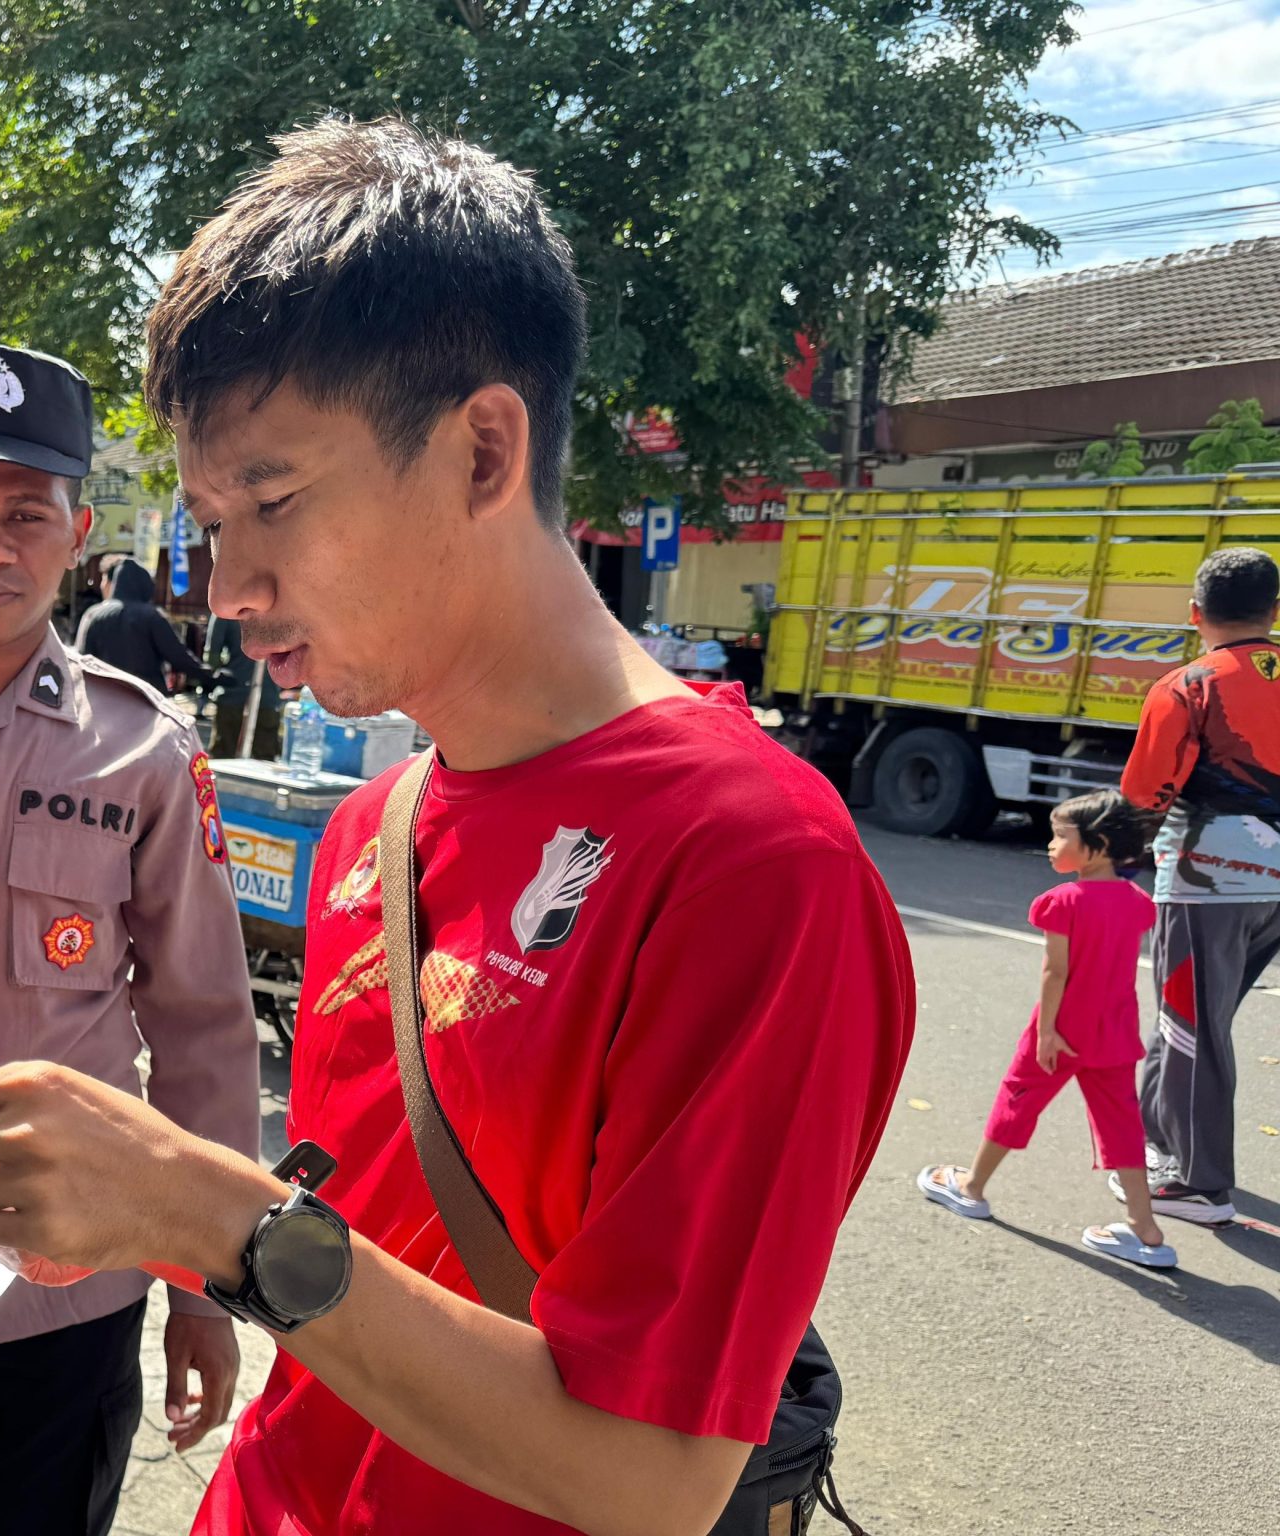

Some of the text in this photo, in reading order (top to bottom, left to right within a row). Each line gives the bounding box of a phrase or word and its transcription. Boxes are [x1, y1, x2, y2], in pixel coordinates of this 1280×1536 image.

[646, 507, 674, 560] P
[19, 789, 136, 835] POLRI
[231, 866, 288, 904] ONAL
